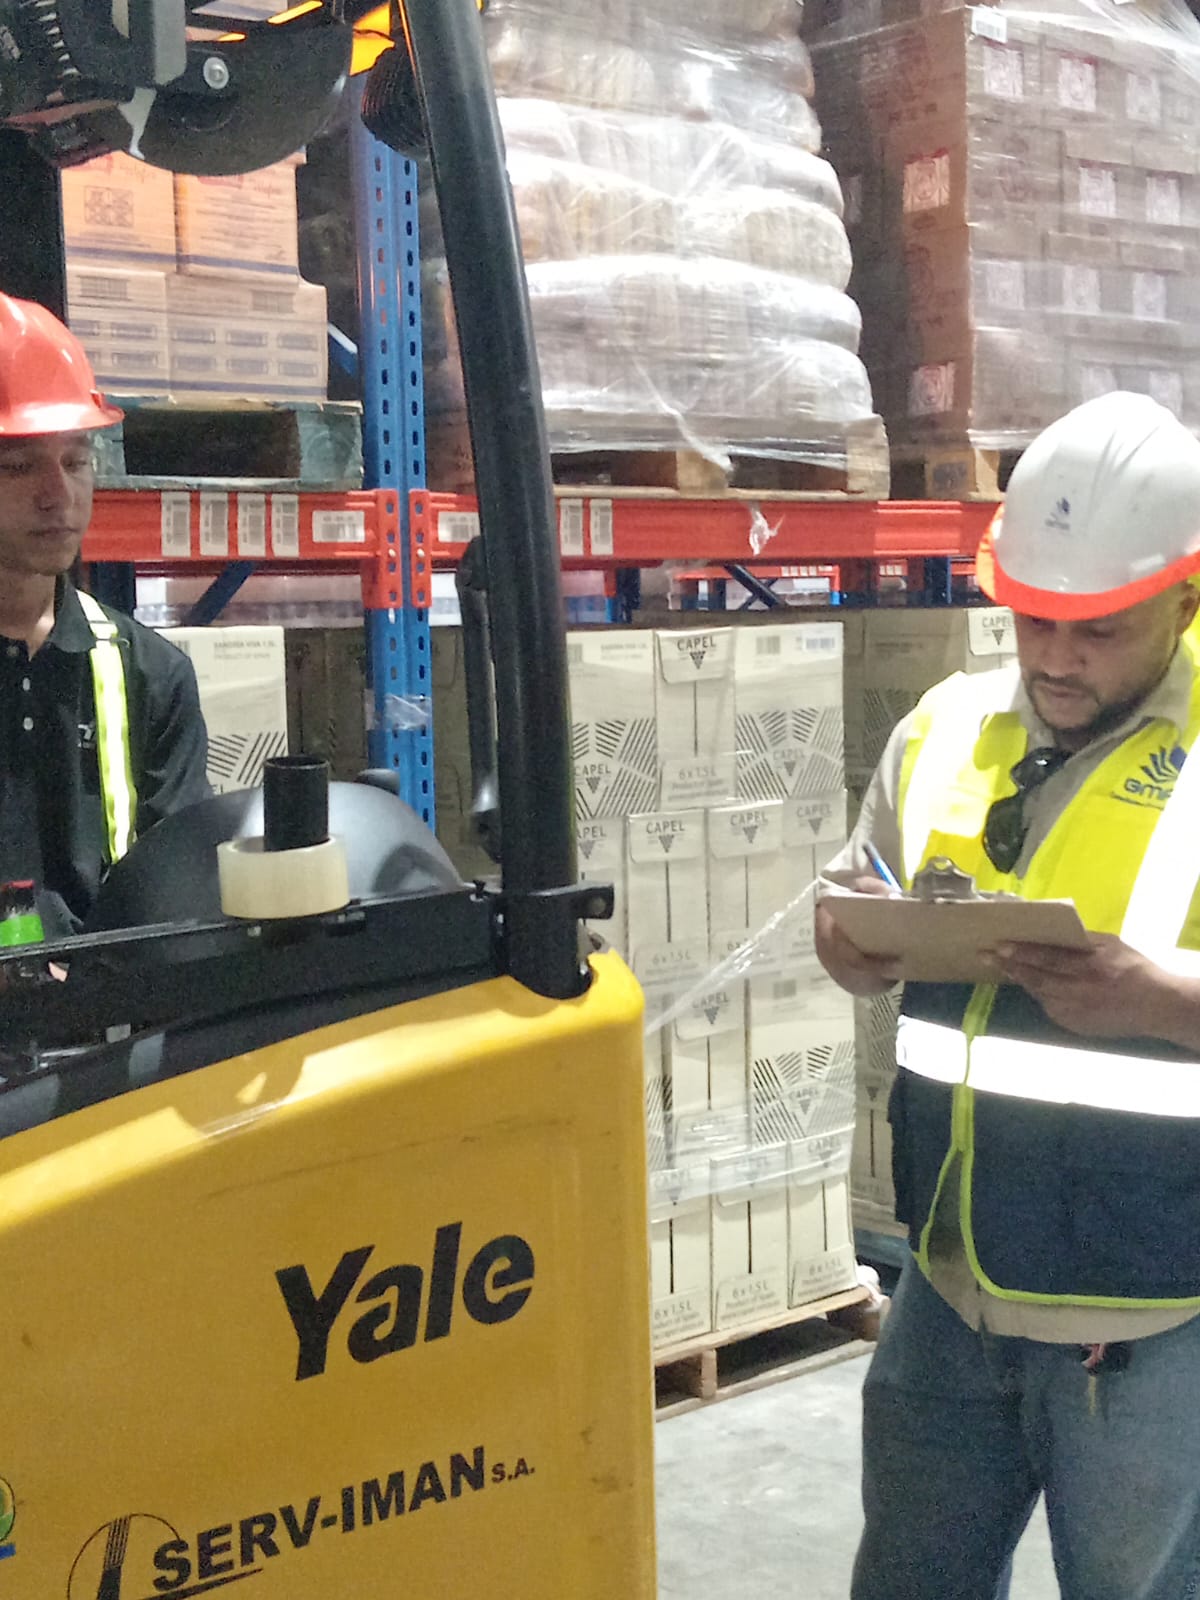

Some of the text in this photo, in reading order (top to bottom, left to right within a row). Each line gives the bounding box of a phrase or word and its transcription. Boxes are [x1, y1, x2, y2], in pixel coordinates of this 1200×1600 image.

[677, 635, 716, 651] CAPEL
[575, 763, 611, 777] CAPEL
[796, 803, 832, 818] CAPEL
[730, 811, 768, 826] CAPEL
[646, 820, 685, 834] CAPEL
[692, 992, 729, 1009] CAPEL
[275, 1221, 535, 1381] Yale
[153, 1445, 535, 1593] SERV-IMAN S.A.
